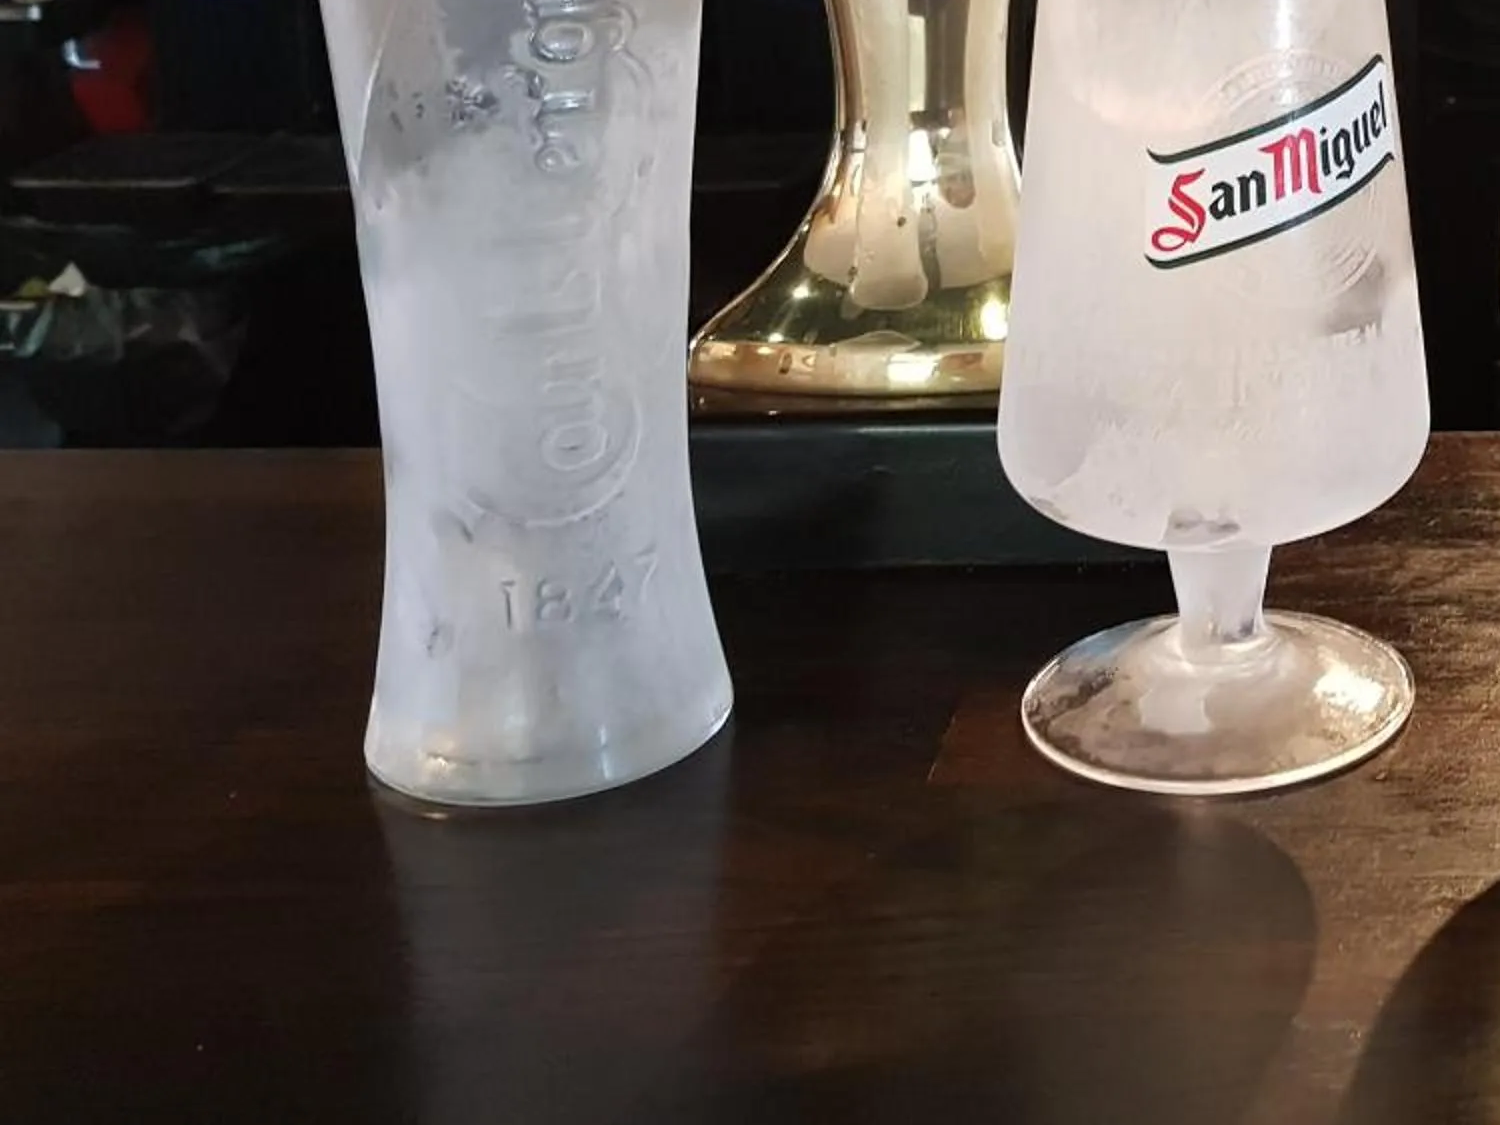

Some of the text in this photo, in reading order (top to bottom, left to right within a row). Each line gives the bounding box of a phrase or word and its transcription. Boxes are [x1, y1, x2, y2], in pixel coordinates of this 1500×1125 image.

[1151, 79, 1388, 252] San Miguel
[499, 541, 659, 631] 1847
